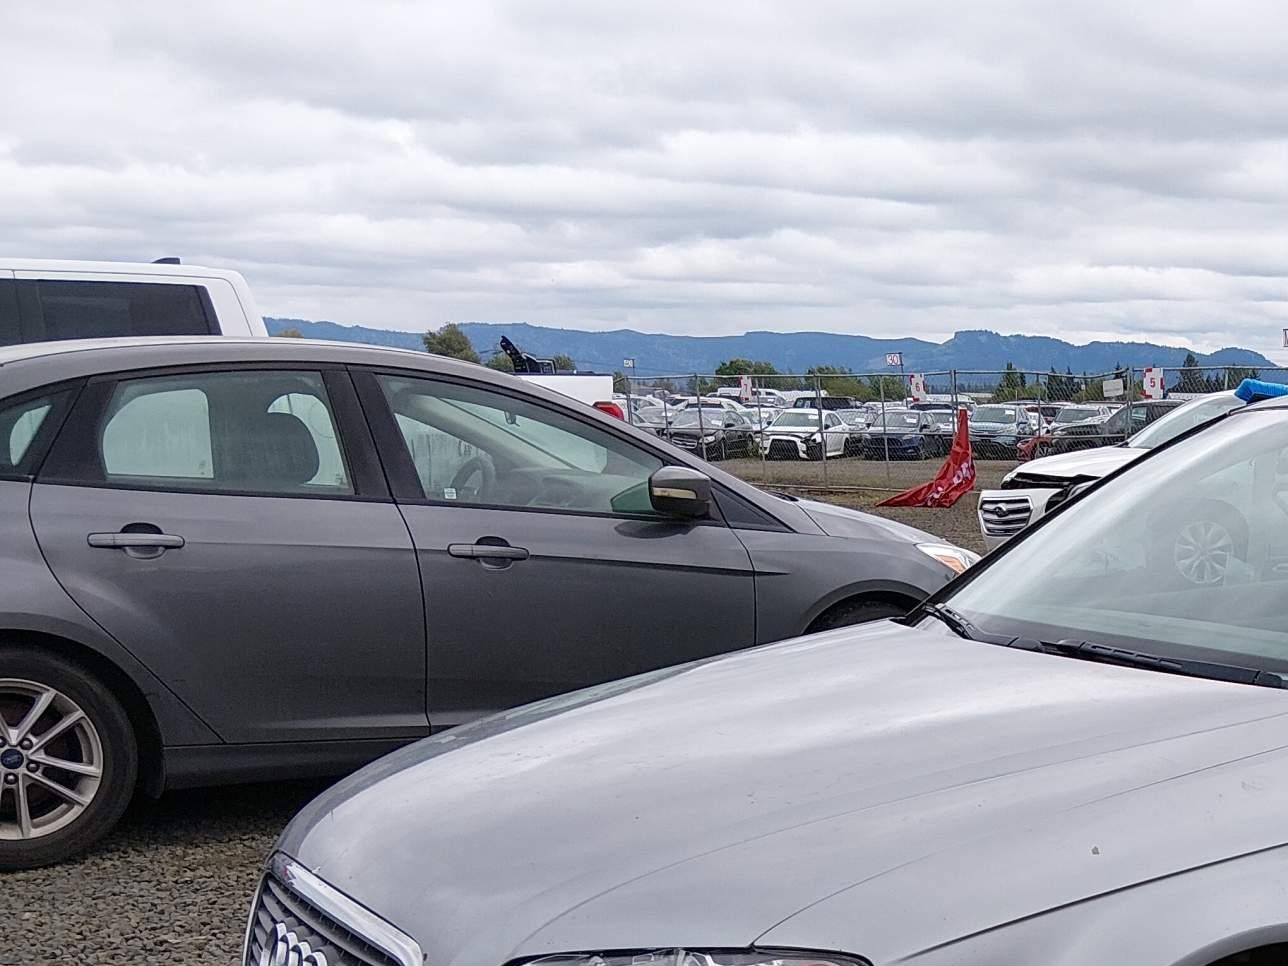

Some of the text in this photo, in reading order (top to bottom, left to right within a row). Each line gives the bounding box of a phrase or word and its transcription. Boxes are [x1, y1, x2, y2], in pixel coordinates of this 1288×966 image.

[887, 354, 899, 365] 30
[915, 382, 921, 392] 6
[1149, 377, 1156, 388] 5
